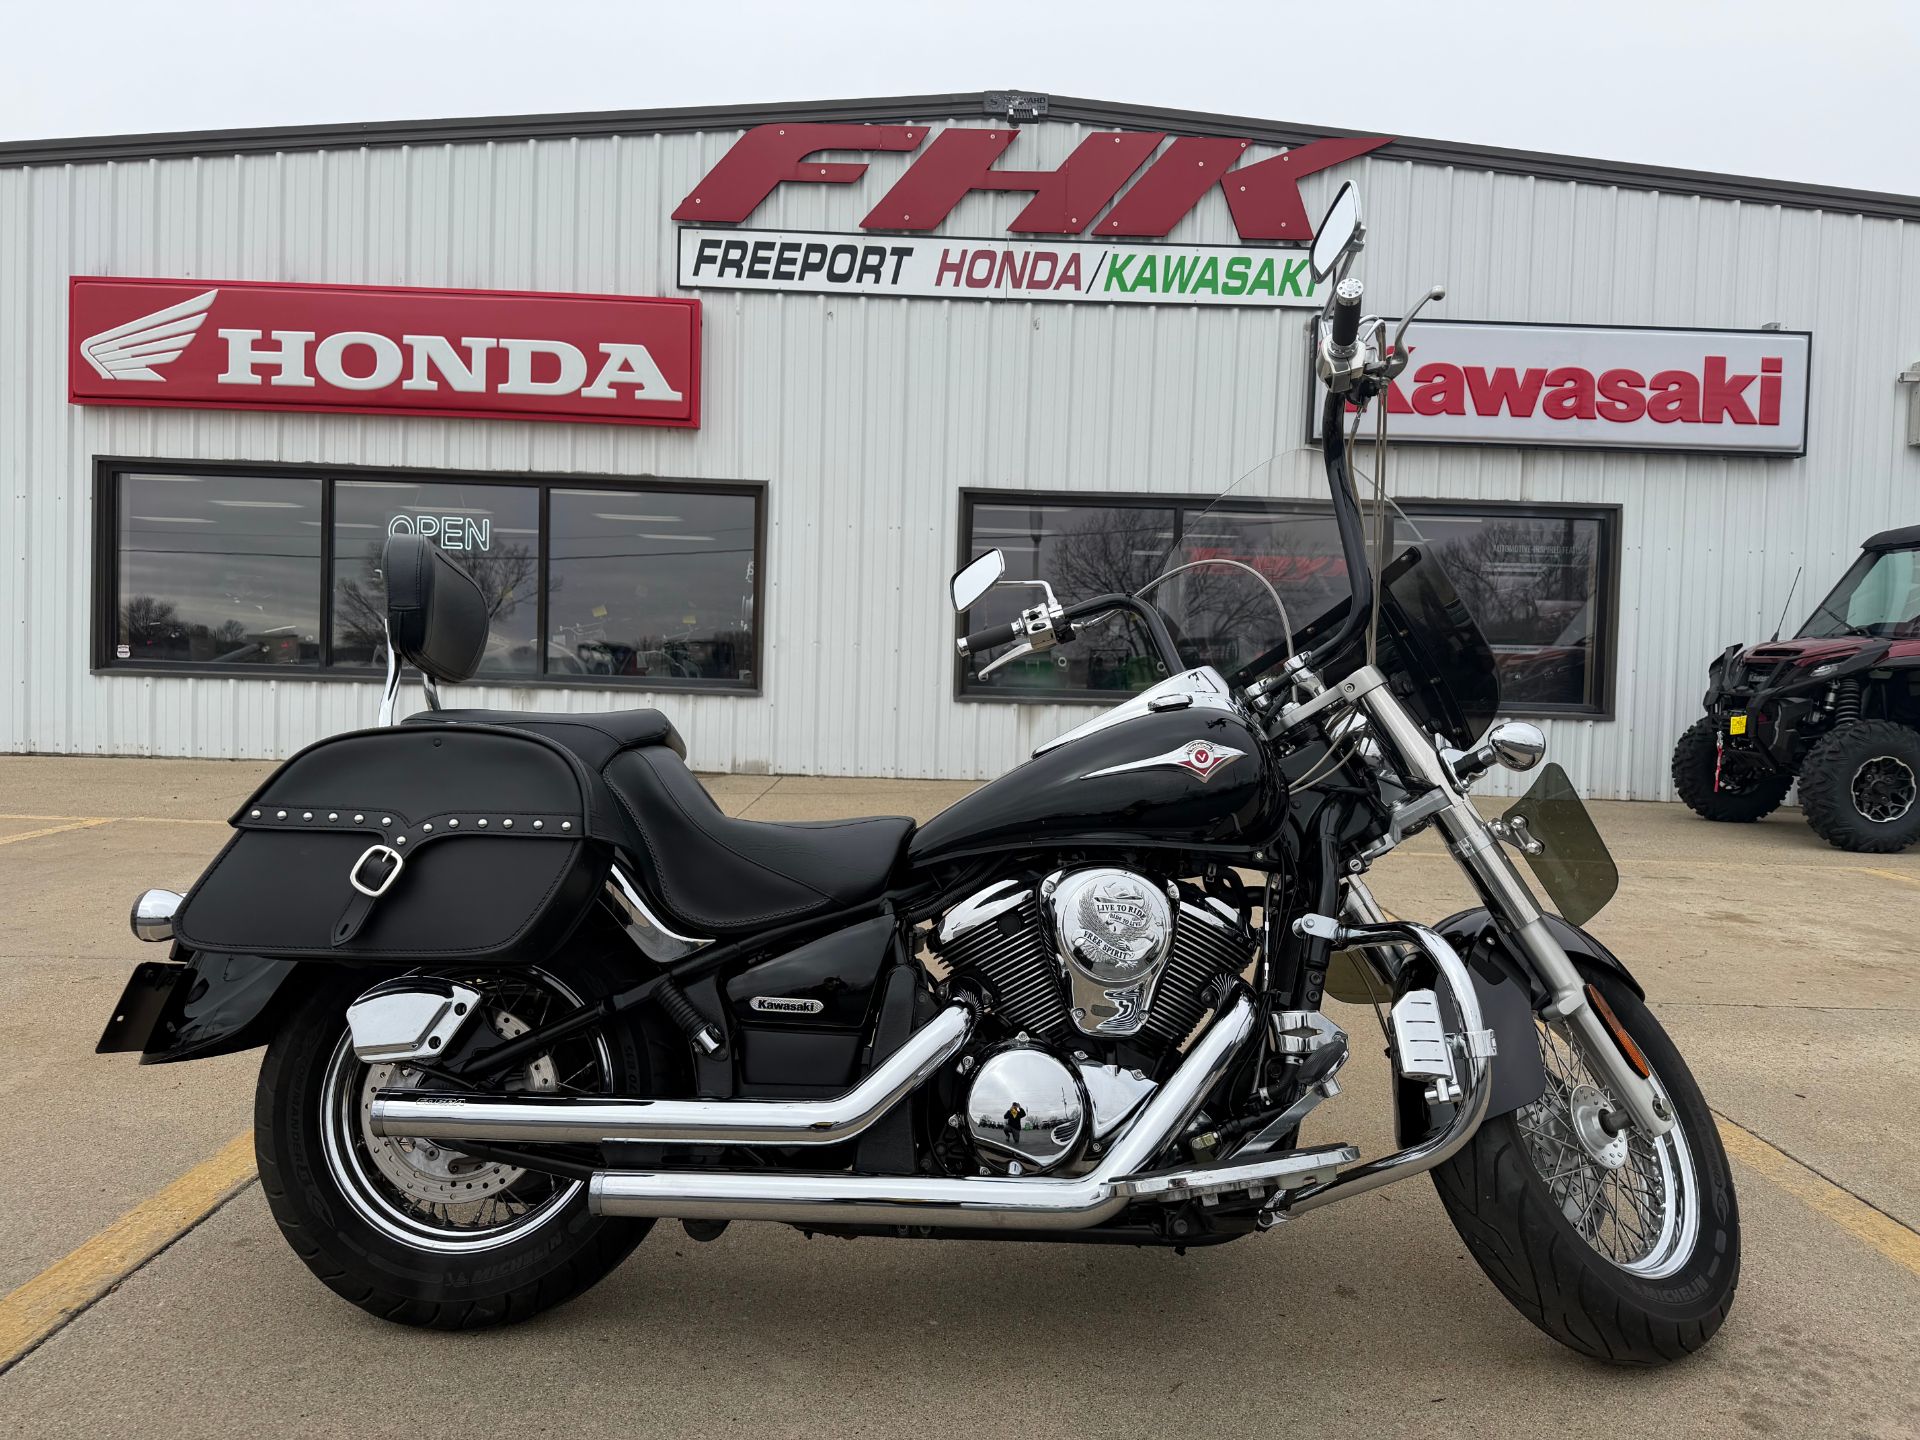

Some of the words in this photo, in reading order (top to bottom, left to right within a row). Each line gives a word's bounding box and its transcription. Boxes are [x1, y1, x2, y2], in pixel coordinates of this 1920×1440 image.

[671, 122, 1399, 239] FHK
[692, 238, 914, 286] FREEPORT
[217, 328, 684, 402] HONDA
[388, 514, 490, 551] OPEN
[1097, 904, 1115, 912] LIVE
[1117, 904, 1127, 912] TO
[1128, 905, 1146, 920] RIDE
[1083, 930, 1102, 946] FREE
[1102, 943, 1128, 960] SPIRIT
[758, 999, 814, 1011] Kawasaki
[1645, 1274, 1710, 1303] MICHELIN
